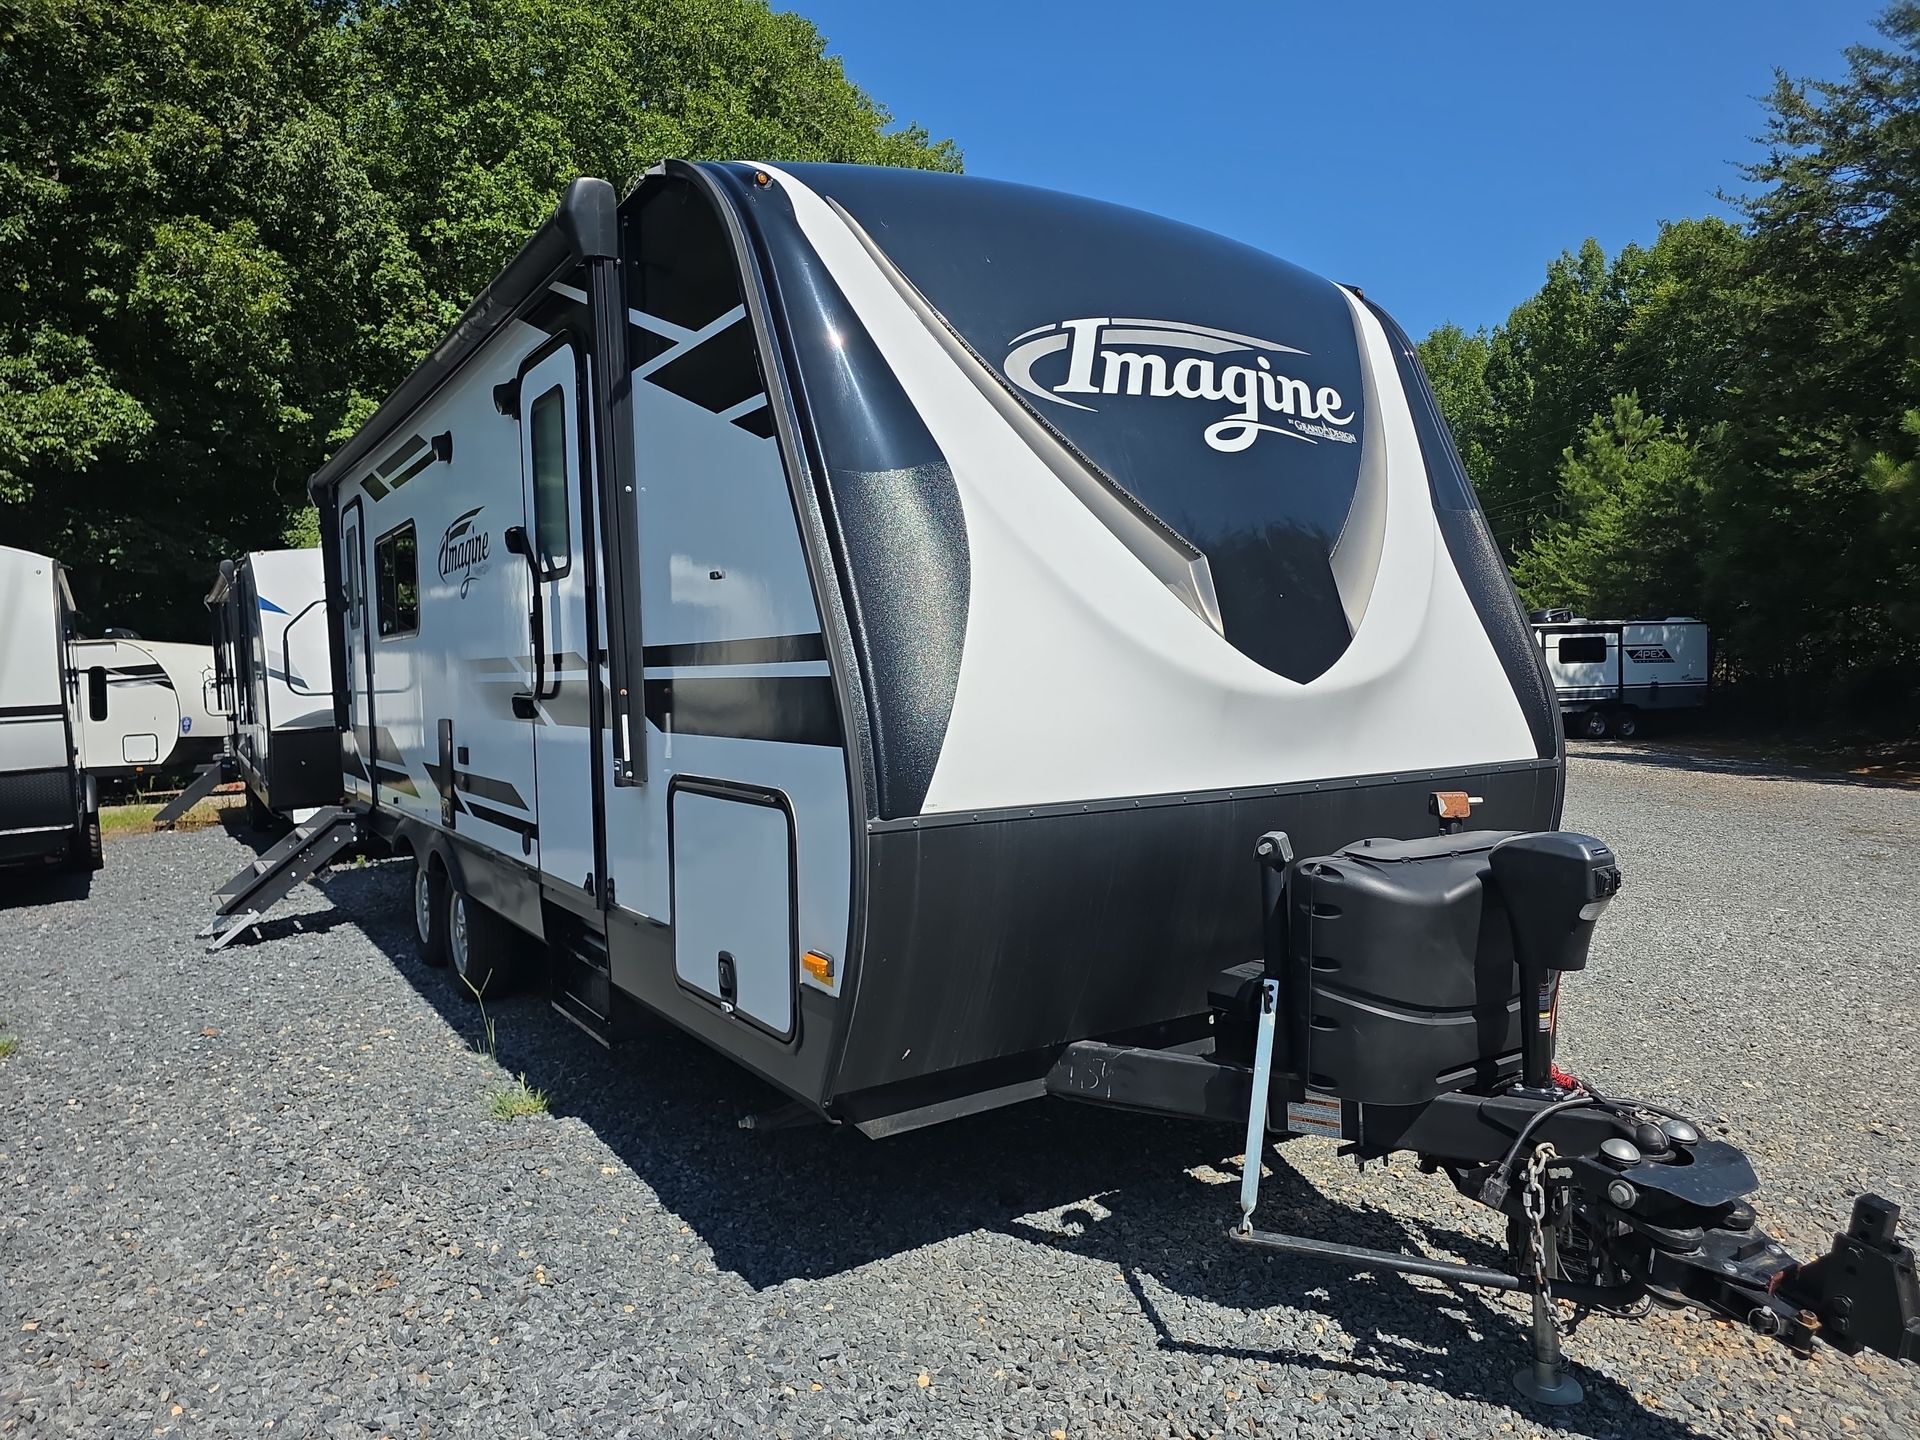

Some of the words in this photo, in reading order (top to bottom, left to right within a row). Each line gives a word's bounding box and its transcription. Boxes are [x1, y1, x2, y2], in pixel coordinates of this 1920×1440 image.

[1053, 317, 1355, 453] Imagine
[443, 525, 490, 600] Imagine
[1633, 649, 1665, 659] APEX
